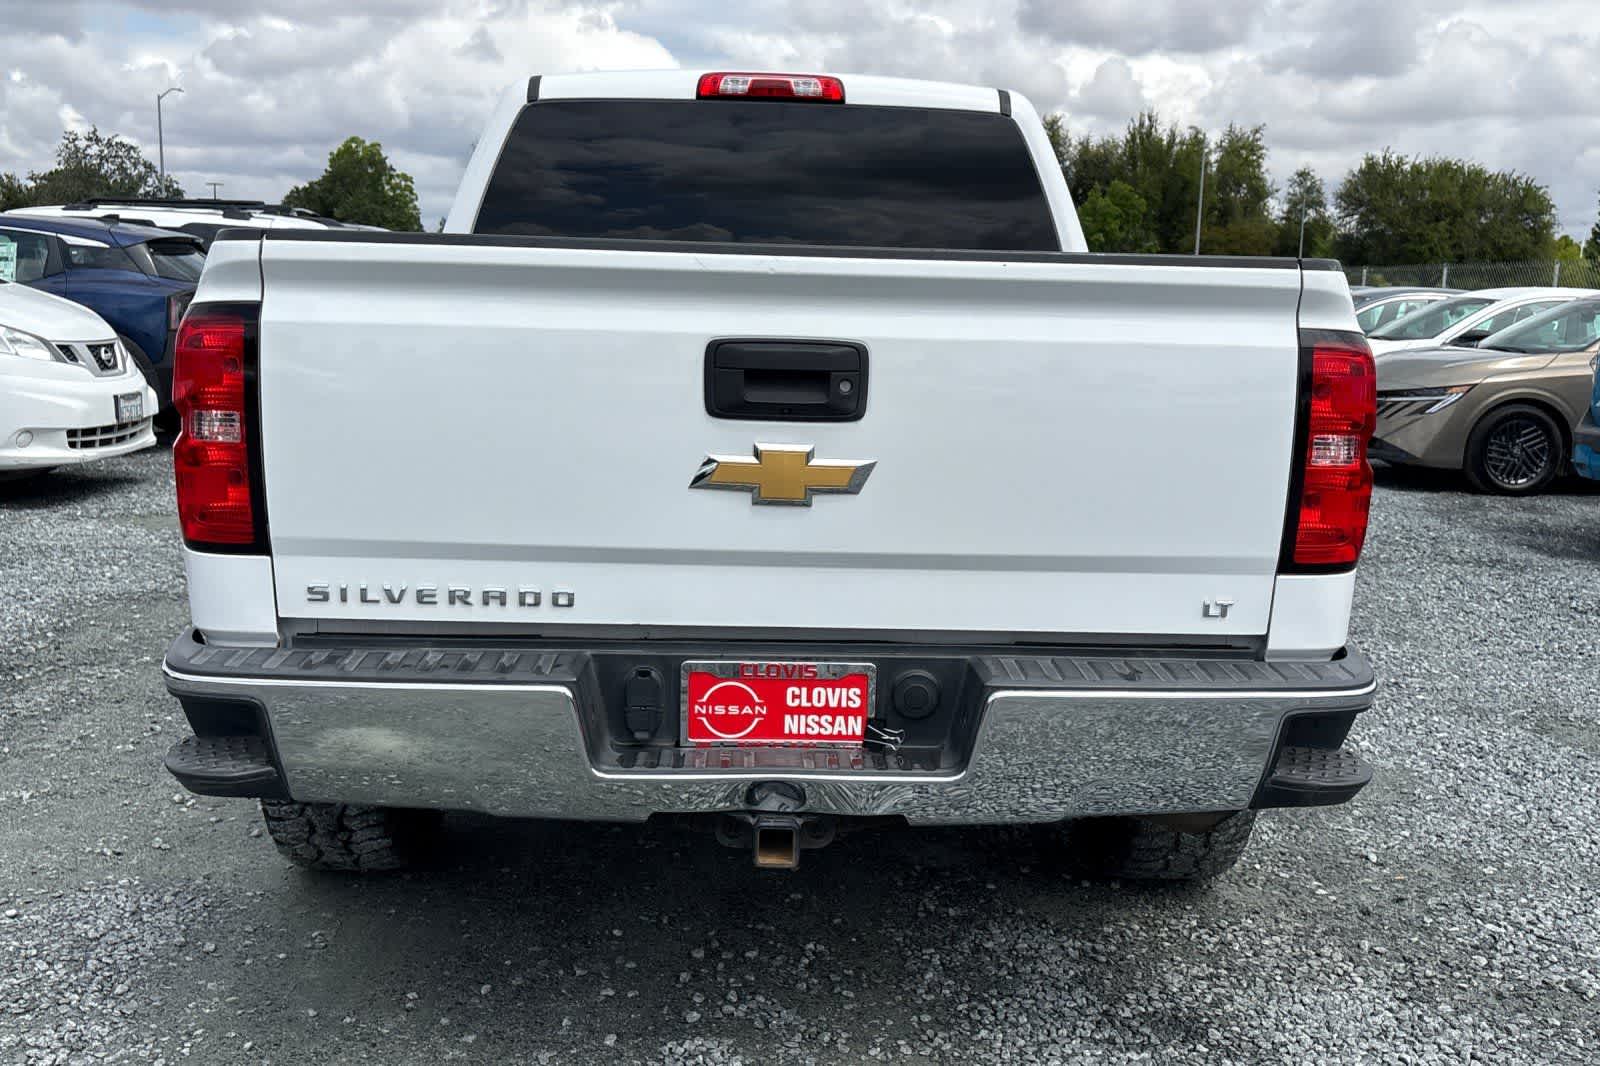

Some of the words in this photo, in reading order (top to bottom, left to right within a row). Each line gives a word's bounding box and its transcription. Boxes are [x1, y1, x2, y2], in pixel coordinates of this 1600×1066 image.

[306, 584, 576, 608] SILVERADO
[1202, 600, 1234, 618] LT
[739, 664, 818, 679] CLOVIS
[786, 686, 862, 708] CLOVIS
[694, 704, 767, 716] NISSAN
[783, 714, 862, 736] NISSAN
